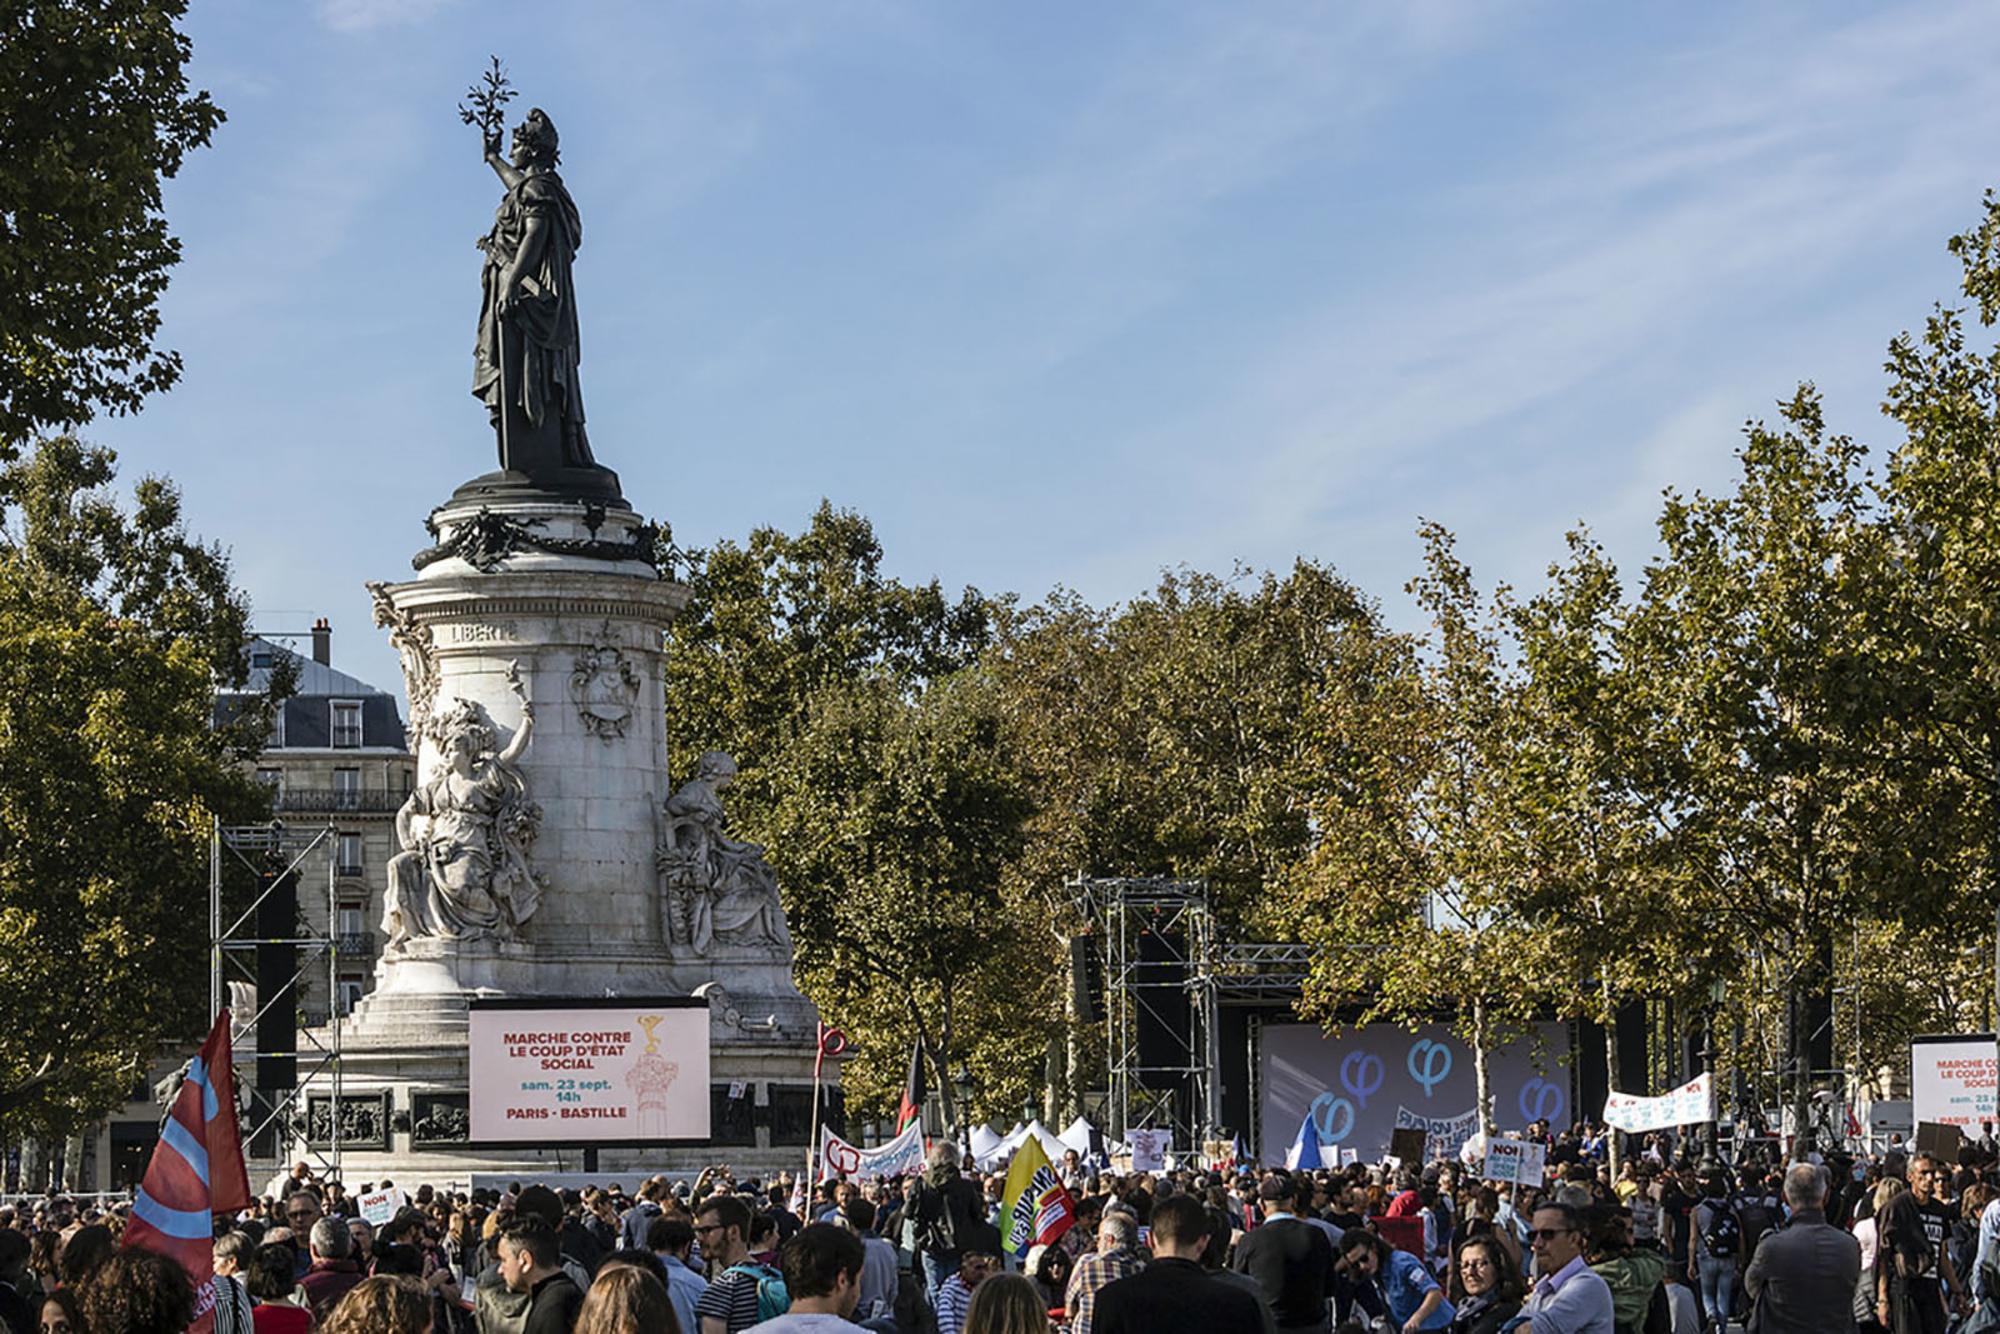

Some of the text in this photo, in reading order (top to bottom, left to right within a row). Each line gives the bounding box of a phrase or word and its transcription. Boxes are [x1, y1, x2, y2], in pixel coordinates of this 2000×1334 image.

[504, 1032, 631, 1044] MARCHE CONTRE
[510, 1046, 526, 1057] LE
[529, 1046, 573, 1057] COUP
[541, 1059, 594, 1070] SOCIAL
[1936, 1060, 1982, 1068] MARCHE
[1941, 1070, 1953, 1079] LE
[1956, 1069, 1986, 1078] COUP
[521, 1079, 612, 1092] sam. 23 sept.
[556, 1092, 581, 1102] 14h
[506, 1108, 549, 1119] PARIS
[561, 1107, 627, 1118] BASTILLE
[363, 1195, 387, 1207] NON
